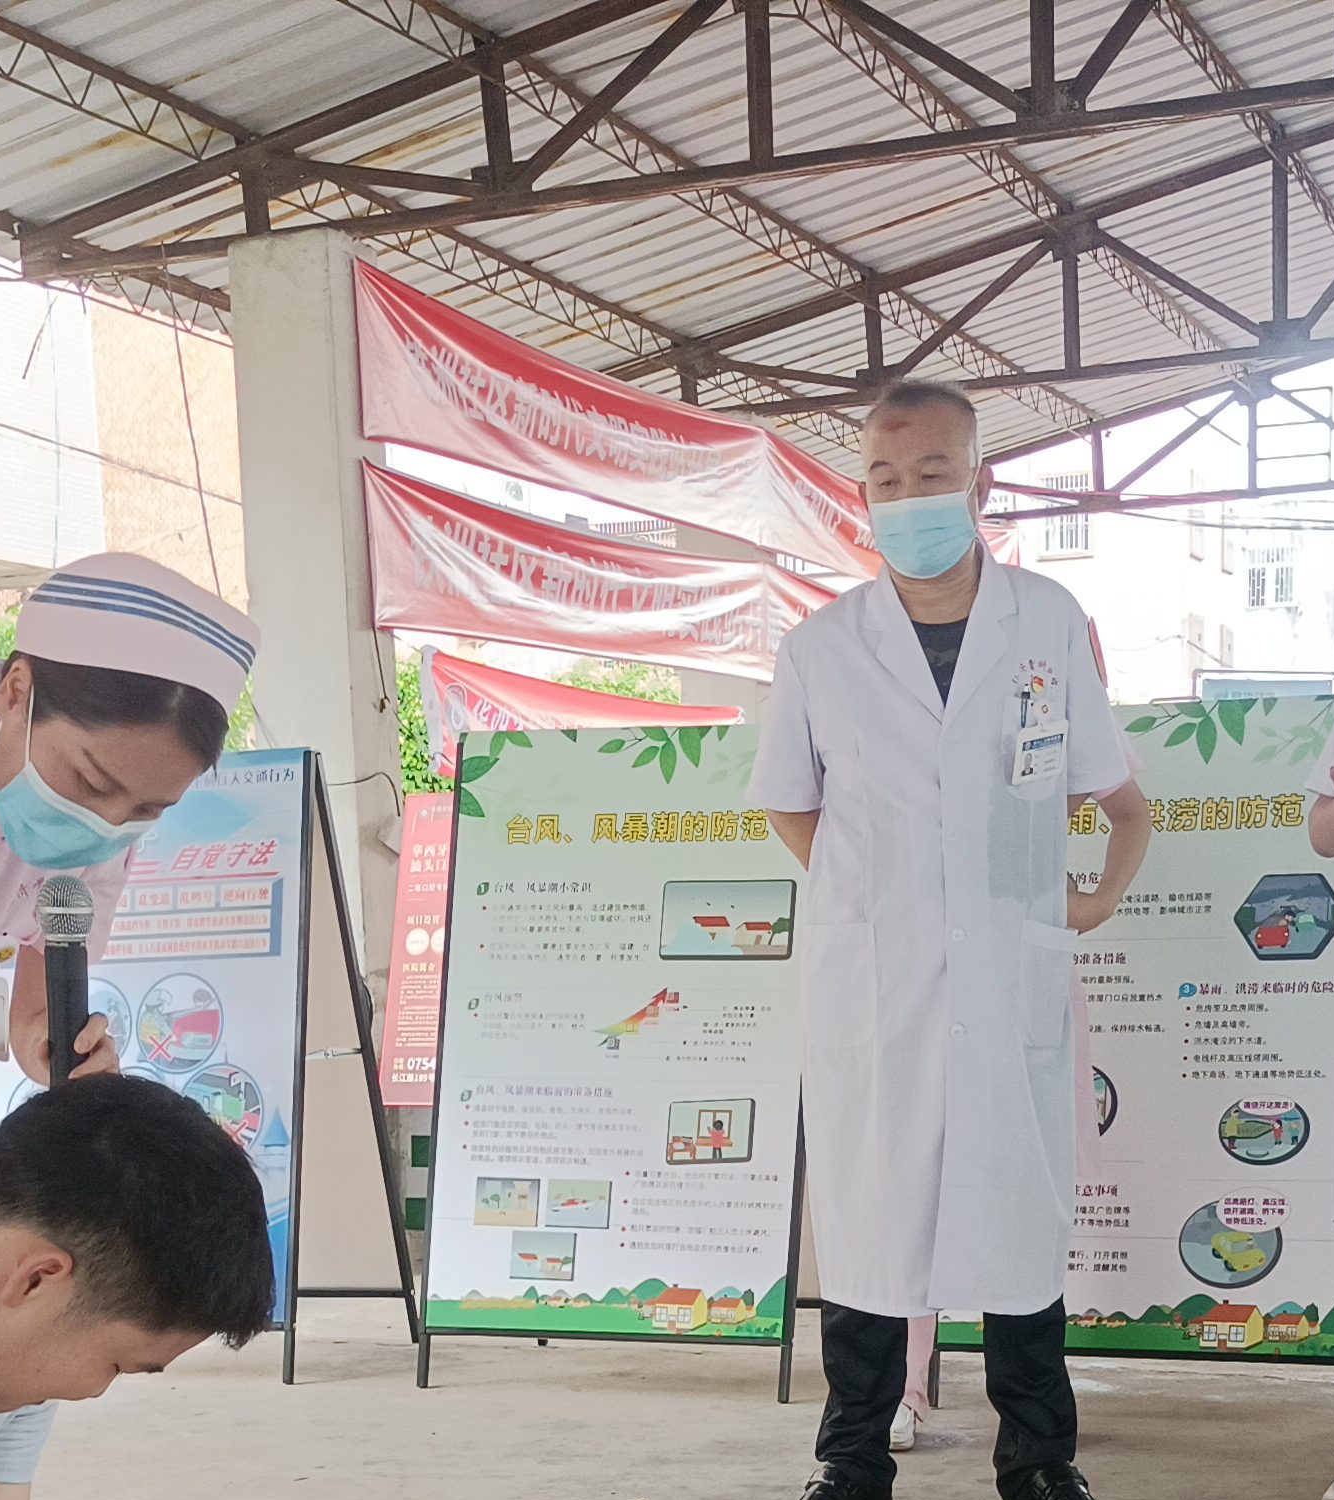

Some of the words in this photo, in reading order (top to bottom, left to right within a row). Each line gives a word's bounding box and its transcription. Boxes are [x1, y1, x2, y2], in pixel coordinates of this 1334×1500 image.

[506, 810, 769, 845] 台风、风暴潮的防范
[171, 840, 277, 871] 自觉守法
